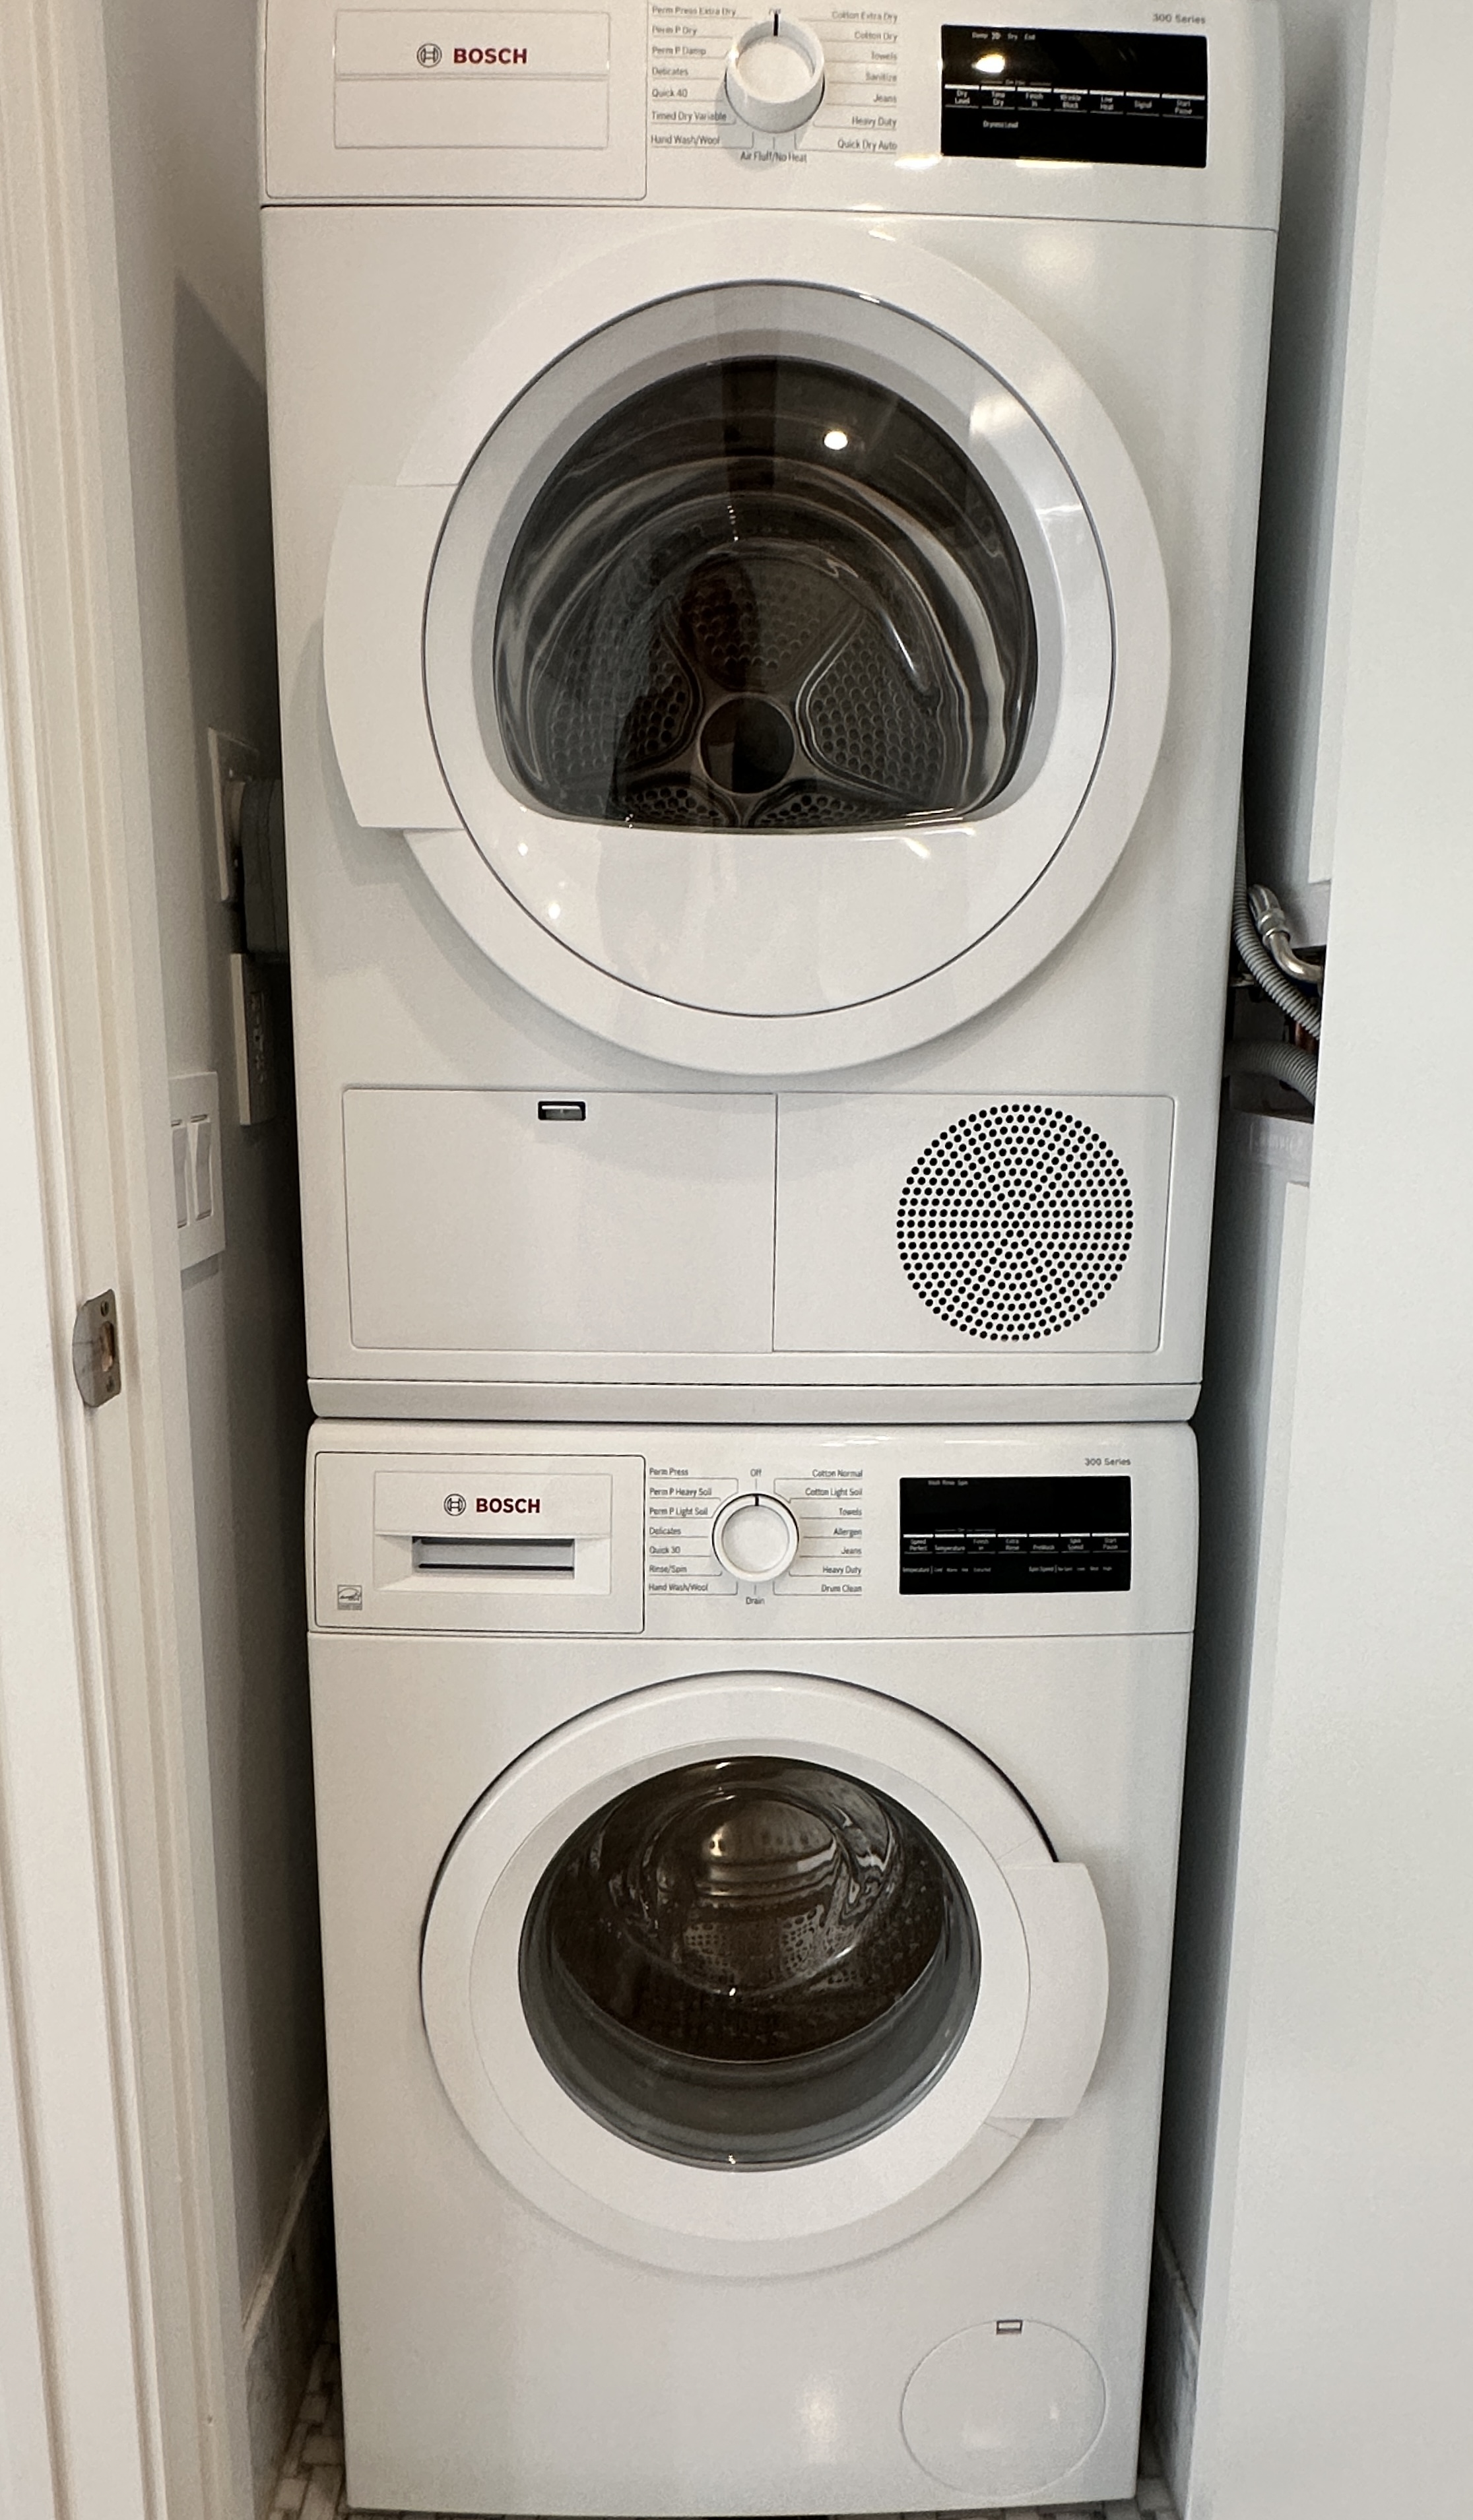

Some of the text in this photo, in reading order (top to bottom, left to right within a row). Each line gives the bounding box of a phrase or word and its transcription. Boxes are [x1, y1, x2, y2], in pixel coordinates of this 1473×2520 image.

[722, 8, 736, 16] Dry
[884, 13, 898, 22] Dry
[1152, 13, 1206, 24] 300 Series
[682, 27, 697, 36] Dry
[884, 32, 898, 42] Dry
[682, 47, 706, 55] Damp
[453, 48, 527, 64] BOSCH
[652, 67, 688, 75] Delicates
[652, 88, 674, 97] Quick
[652, 112, 727, 122] Timed Dry Variable
[852, 116, 896, 127] Heavy Duty
[651, 135, 720, 145] Hand Wash/Wool
[837, 139, 898, 151] Quick Dry Auto
[740, 151, 752, 160] Air
[1084, 1458, 1131, 1466] 300 Series
[649, 1467, 688, 1475] Perm Press
[750, 1469, 762, 1477] Off
[812, 1469, 863, 1477] Cotton Normal
[676, 1488, 697, 1498] Heavy
[699, 1487, 712, 1496] Soil
[805, 1487, 829, 1496] Cotton
[830, 1487, 847, 1498] Light
[476, 1499, 540, 1513] BOSCH
[676, 1507, 693, 1517] Light
[839, 1507, 862, 1516] Towels
[649, 1526, 681, 1535] Delicates
[834, 1528, 862, 1538] Allergen
[841, 1546, 862, 1555] Jeans
[649, 1565, 687, 1573] Rinse/Spin
[822, 1565, 861, 1575] Heavy Duty
[821, 1584, 862, 1592] Drum Clean
[746, 1597, 765, 1605] Drain
